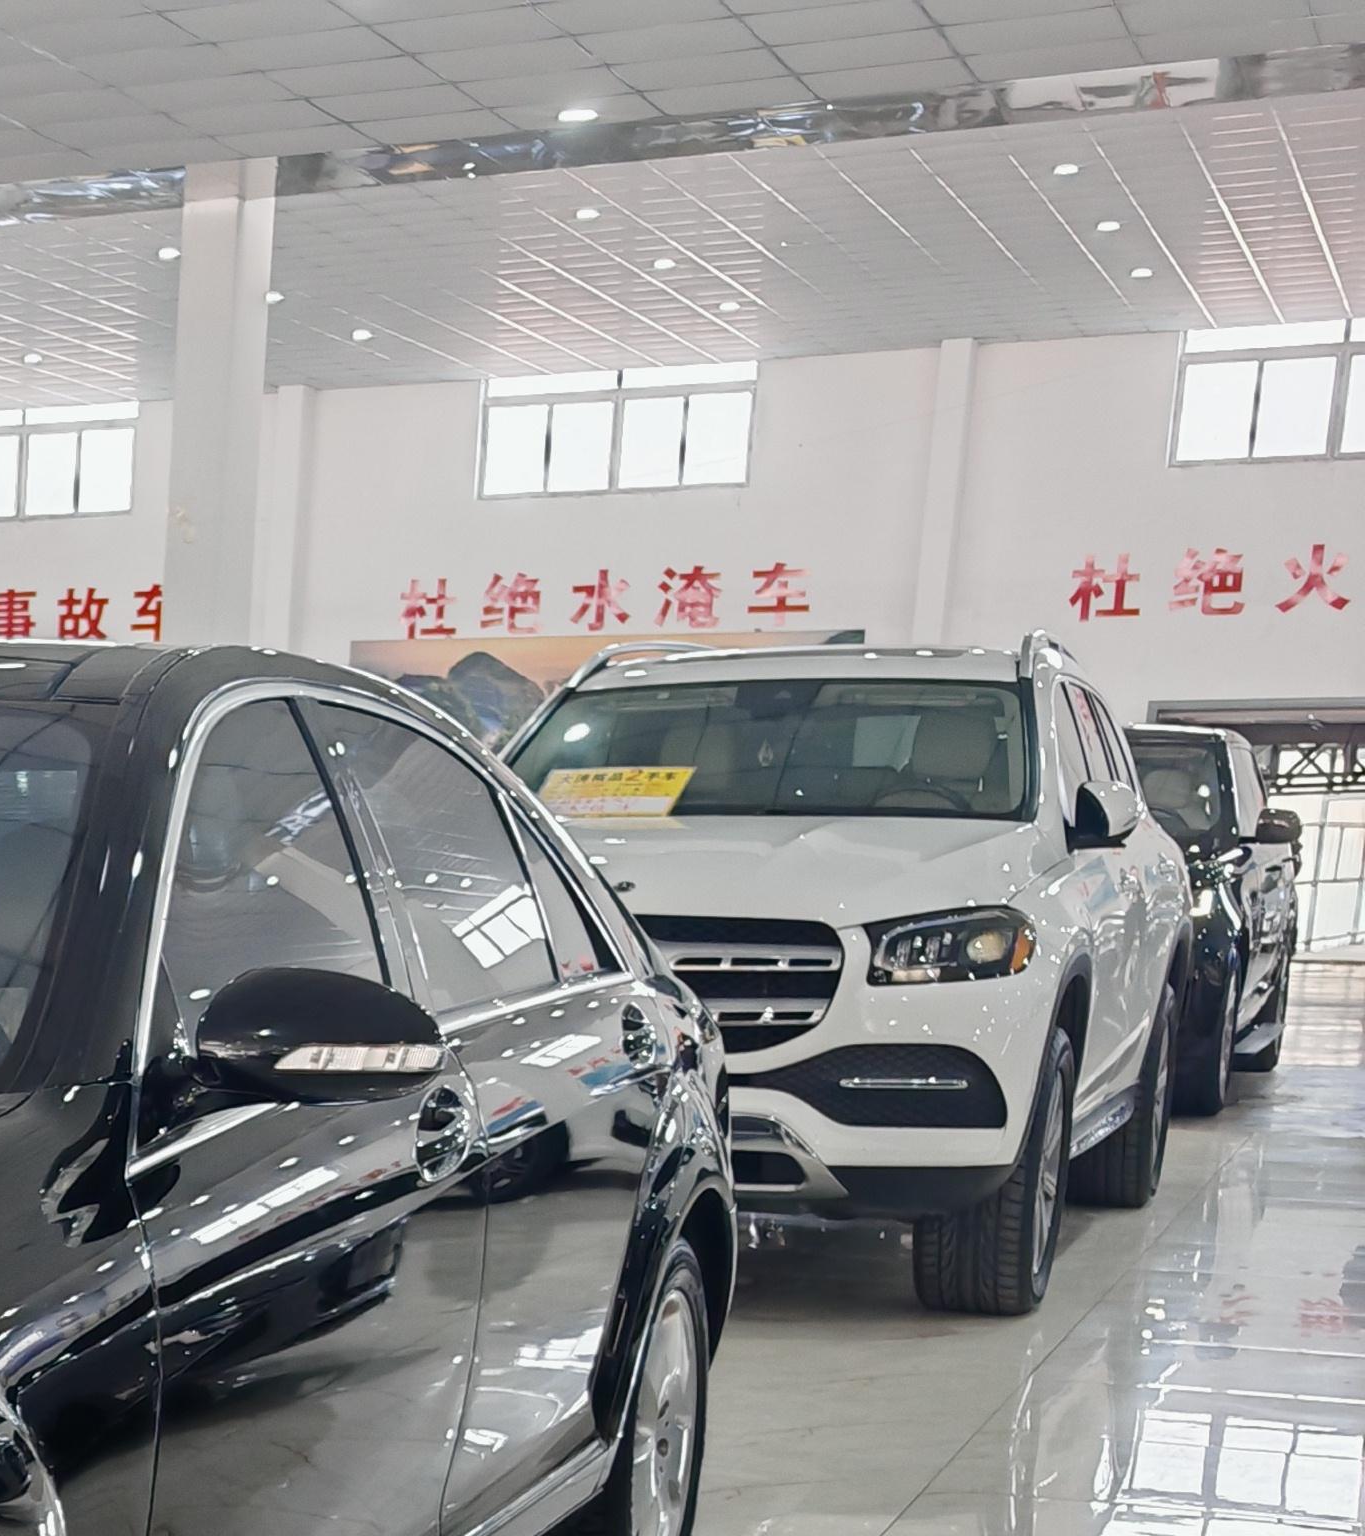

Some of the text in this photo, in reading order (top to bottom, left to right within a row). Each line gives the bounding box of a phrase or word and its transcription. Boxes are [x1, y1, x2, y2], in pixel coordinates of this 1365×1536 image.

[400, 562, 810, 640] 杜绝水淹车
[1069, 544, 1351, 622] 杜绝火
